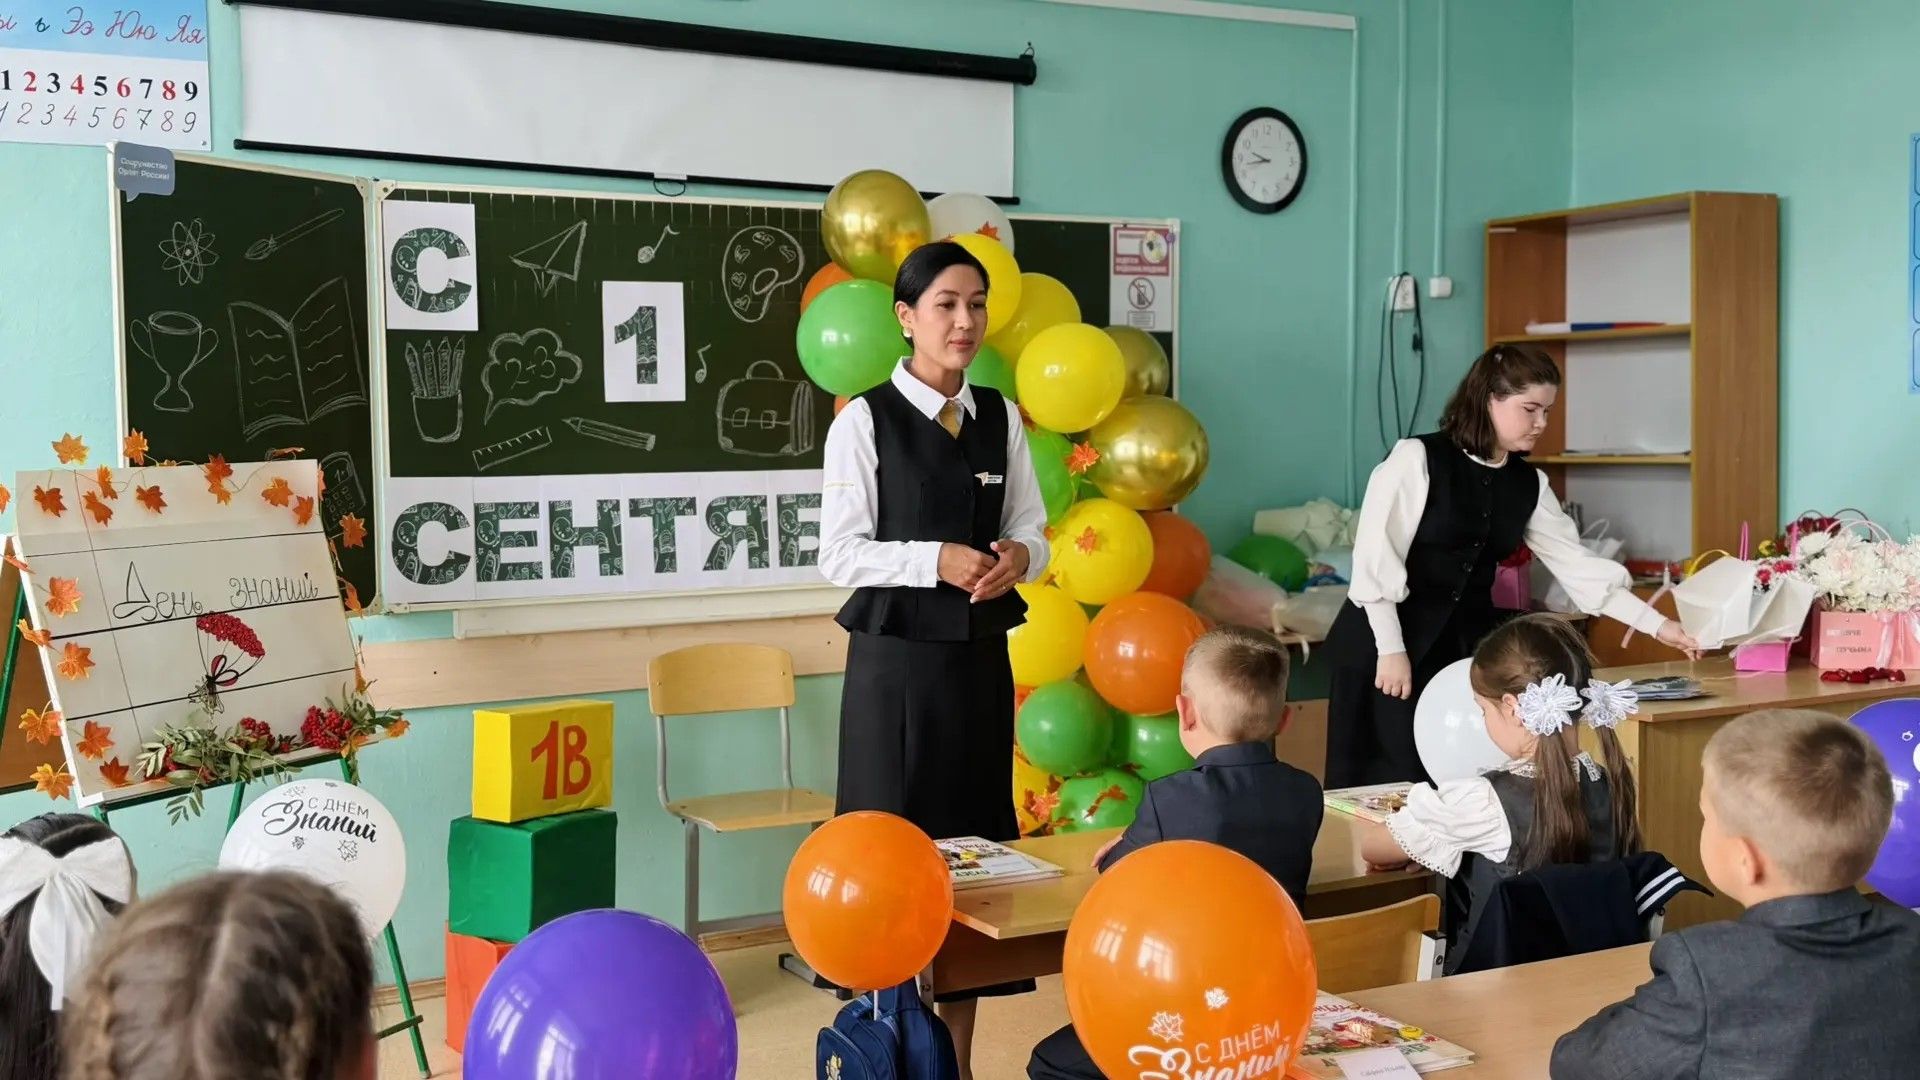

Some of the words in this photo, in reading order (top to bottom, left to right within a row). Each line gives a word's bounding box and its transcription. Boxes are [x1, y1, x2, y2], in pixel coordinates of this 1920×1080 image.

[62, 6, 95, 36] Ээ
[105, 10, 157, 40] Юю
[166, 14, 205, 44] Яя
[1, 70, 12, 91] 1
[23, 71, 37, 92] 2
[46, 73, 61, 93] 3
[70, 74, 85, 95] 4
[94, 76, 108, 96] 5
[117, 77, 131, 98] 6
[139, 79, 153, 99] 7
[162, 80, 176, 100] 8
[184, 81, 198, 101] 9
[0, 101, 9, 122] 1
[17, 102, 33, 125] 2
[40, 104, 55, 126] 3
[63, 105, 77, 127] 4
[87, 107, 106, 128] 5
[112, 108, 127, 130] 6
[137, 109, 152, 130] 7
[160, 110, 174, 132] 8
[182, 112, 197, 133] 9
[390, 227, 472, 313] С
[614, 305, 657, 385] 1
[112, 561, 204, 622] День
[228, 572, 319, 609] знаний
[530, 720, 592, 800] 1В
[261, 799, 377, 843] Знаний
[1195, 1043, 1211, 1064] С
[1219, 1019, 1281, 1063] ДНЁМ
